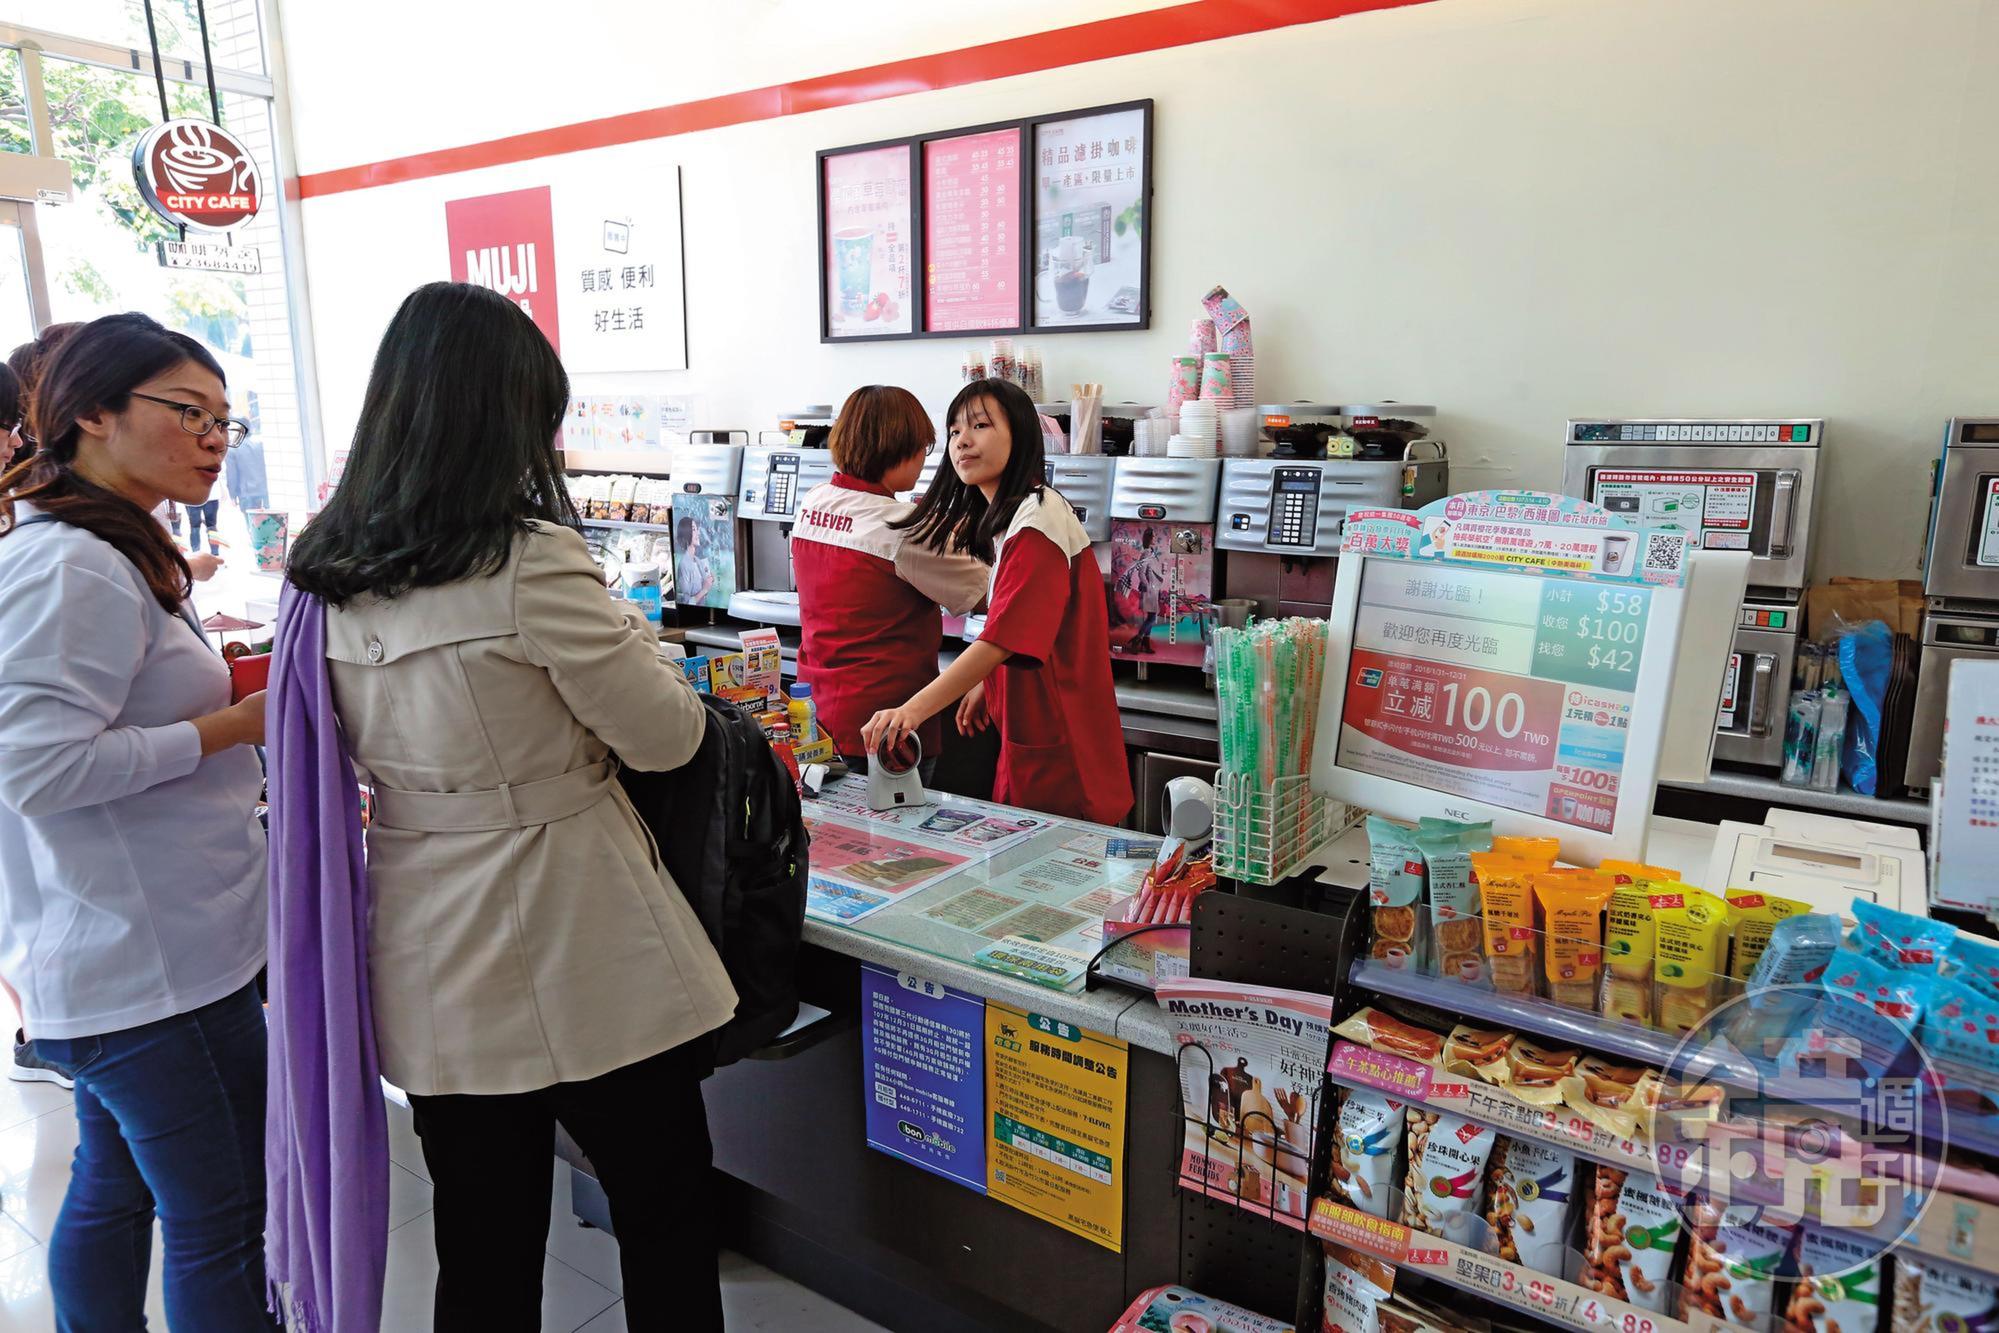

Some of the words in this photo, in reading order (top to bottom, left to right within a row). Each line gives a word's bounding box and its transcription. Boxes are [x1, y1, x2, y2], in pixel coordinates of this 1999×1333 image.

[1041, 136, 1138, 166] 精品濾掛咖啡
[166, 195, 205, 209] CITY
[208, 196, 250, 210] CAFE
[465, 243, 539, 296] MUJI
[580, 268, 614, 293] 質感
[620, 264, 655, 289] 便利
[594, 307, 645, 333] 好生活
[1467, 503, 1560, 523] 東京/巴黎/西雅圖
[1350, 532, 1410, 551] 百萬大獎
[1506, 555, 1525, 564] CITY
[1525, 557, 1546, 566] CAFE
[1546, 589, 1572, 603] 小計
[1595, 589, 1643, 616] $58
[1383, 622, 1499, 655] 歡迎您再度光臨
[1543, 614, 1568, 631] 收您
[1576, 614, 1639, 645] $100
[1538, 641, 1565, 657] 找您
[1587, 647, 1634, 673] $42
[1384, 690, 1433, 720] 立减
[1443, 682, 1526, 739] 100
[1523, 731, 1550, 746] TWD
[1455, 733, 1478, 749] 500
[1568, 767, 1609, 791] 100
[1444, 808, 1470, 821] NEC
[907, 975, 935, 995] 公告
[1039, 1016, 1070, 1038] 公告
[1168, 1000, 1259, 1022] Mother's
[1265, 1008, 1303, 1037] Day
[1029, 1040, 1118, 1080] 服務時間調整公告
[1427, 1141, 1481, 1166] 珍珠開心果
